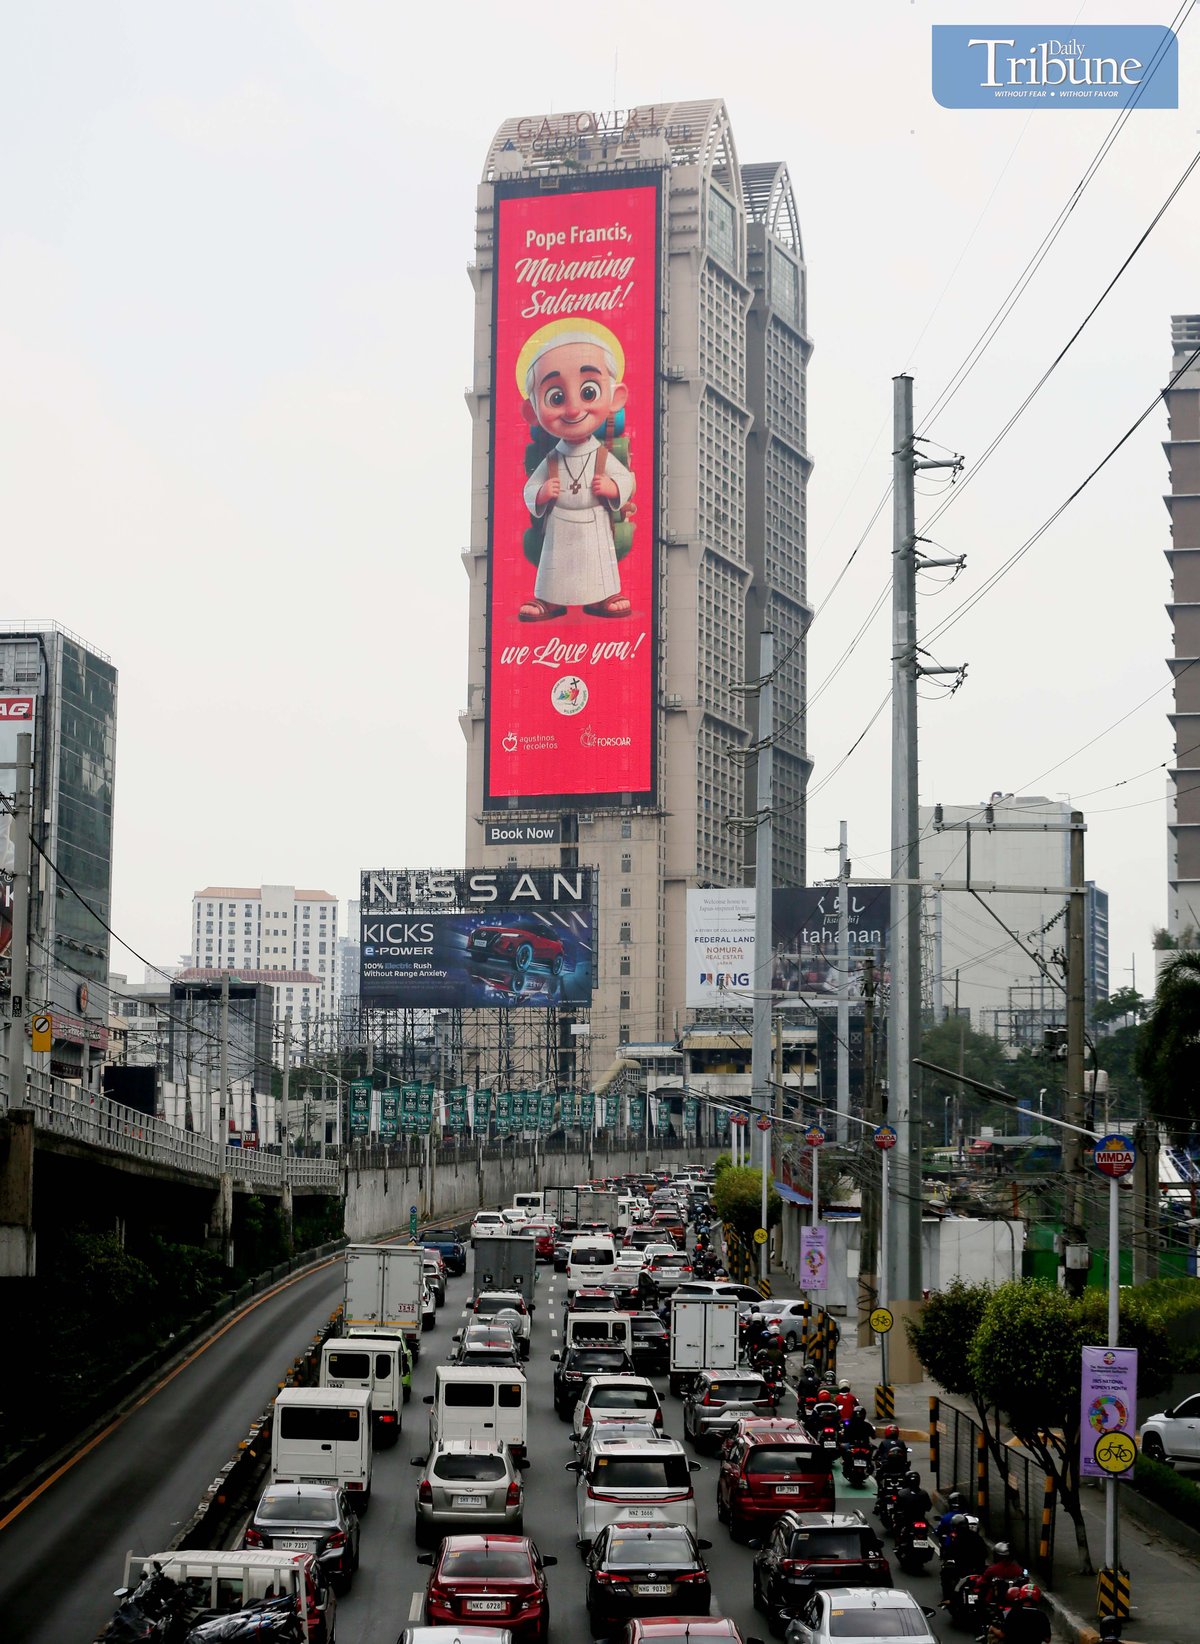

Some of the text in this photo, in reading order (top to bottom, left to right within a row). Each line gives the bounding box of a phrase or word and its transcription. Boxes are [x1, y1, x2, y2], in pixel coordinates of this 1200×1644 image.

[526, 222, 632, 251] Pope Francis,
[514, 251, 636, 288] Maraming
[520, 281, 635, 319] Salamat!
[500, 632, 646, 669] we Love you!
[519, 734, 555, 745] agustinos
[523, 741, 558, 750] recoletos
[597, 737, 632, 747] FORSOAR
[491, 827, 554, 840] Book Now
[369, 873, 583, 904] NISSAN
[363, 923, 434, 943] KICKS
[364, 946, 434, 956] e-POWER
[364, 962, 384, 970] 100%
[394, 970, 418, 978] Range
[419, 970, 447, 978] Anxiety
[1097, 1152, 1132, 1162] MMDA
